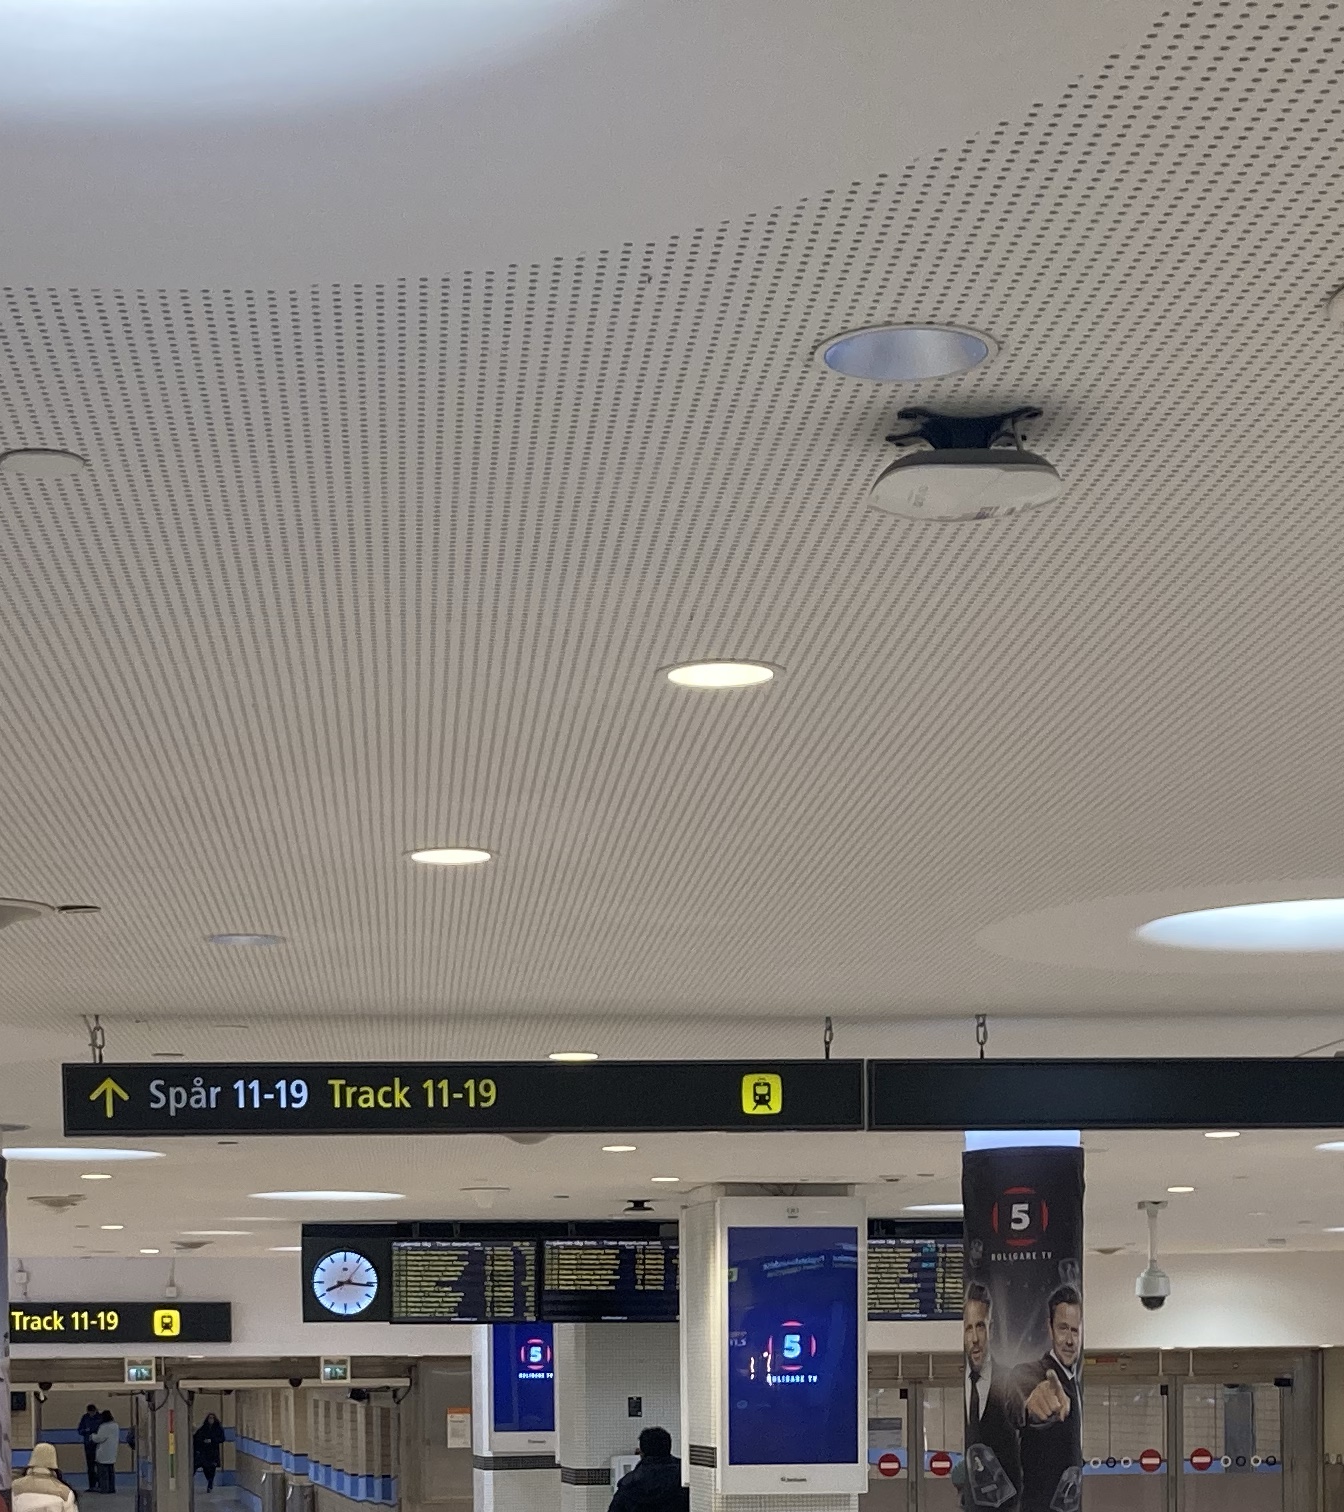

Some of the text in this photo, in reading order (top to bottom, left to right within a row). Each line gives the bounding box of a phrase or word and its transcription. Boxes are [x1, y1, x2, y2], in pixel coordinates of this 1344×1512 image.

[149, 1076, 497, 1117] Spår 11-19 Track 11-19
[1010, 1203, 1030, 1231] 5
[10, 1309, 119, 1331] Track 11-19
[529, 1346, 542, 1362] 5
[783, 1334, 802, 1358] 5
